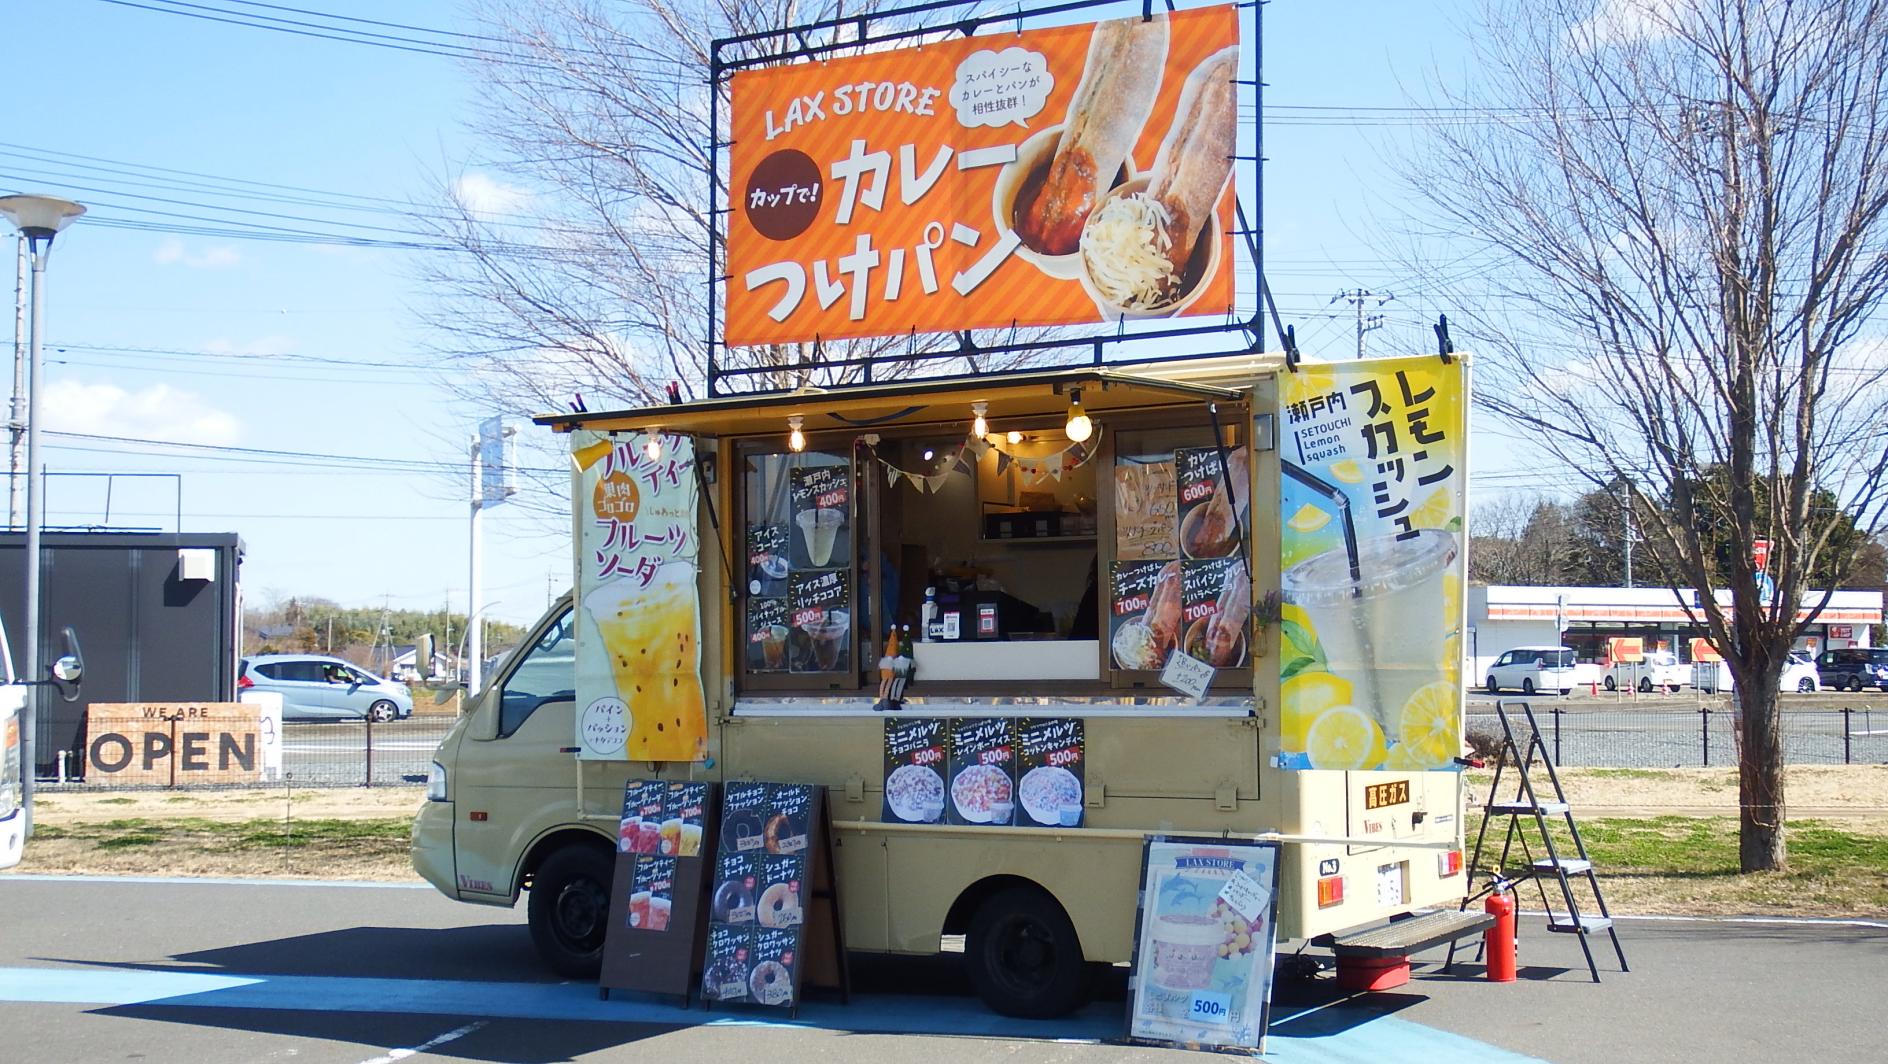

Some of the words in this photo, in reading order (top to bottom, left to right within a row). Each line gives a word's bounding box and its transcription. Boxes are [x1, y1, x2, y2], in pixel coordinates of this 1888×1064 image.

[765, 92, 826, 140] LAX
[832, 81, 940, 117] STORE
[831, 139, 1016, 224] カレー
[750, 183, 820, 208] カップで!
[745, 221, 1022, 323] つけパン
[1286, 391, 1347, 424] 瀬戸内
[1300, 417, 1352, 438] SETOUCHI
[1395, 370, 1454, 487] レモン
[1304, 434, 1340, 450] Lemon
[604, 434, 682, 478] フルツ
[1188, 450, 1219, 469] カレー
[1306, 443, 1346, 462] squash
[1349, 379, 1421, 542] スカッシュ
[640, 459, 693, 494] ティー
[803, 469, 831, 486] 瀬戸内
[1183, 458, 1223, 482] つけぱ
[604, 482, 630, 497] 果肉
[1183, 484, 1213, 502] 600円
[597, 496, 634, 514] ゴロゴロ
[819, 492, 845, 507] 400円
[596, 519, 687, 554] フルーツ
[754, 526, 779, 542] アイス
[757, 538, 785, 552] コーヒー
[596, 550, 661, 588] ソーダ
[1117, 597, 1147, 614] 700円
[1184, 604, 1216, 620] 700円
[143, 707, 167, 718] WE
[176, 707, 209, 718] ARE
[888, 722, 941, 745] ミニメルツ
[954, 721, 1008, 745] ミニメルツ
[1021, 721, 1077, 746] ミニメルツ
[90, 732, 255, 773] OPEN
[914, 749, 941, 765] 500円
[981, 749, 1009, 765] 500円
[1049, 750, 1079, 766] 500円
[1368, 783, 1407, 808] 高圧ガス
[724, 855, 743, 867] チョコ
[765, 859, 796, 872] シュガー
[1206, 859, 1234, 869] STORE
[725, 864, 752, 878] ドーナツ
[767, 869, 795, 883] ドーナツ
[1193, 1000, 1227, 1017] 500円
